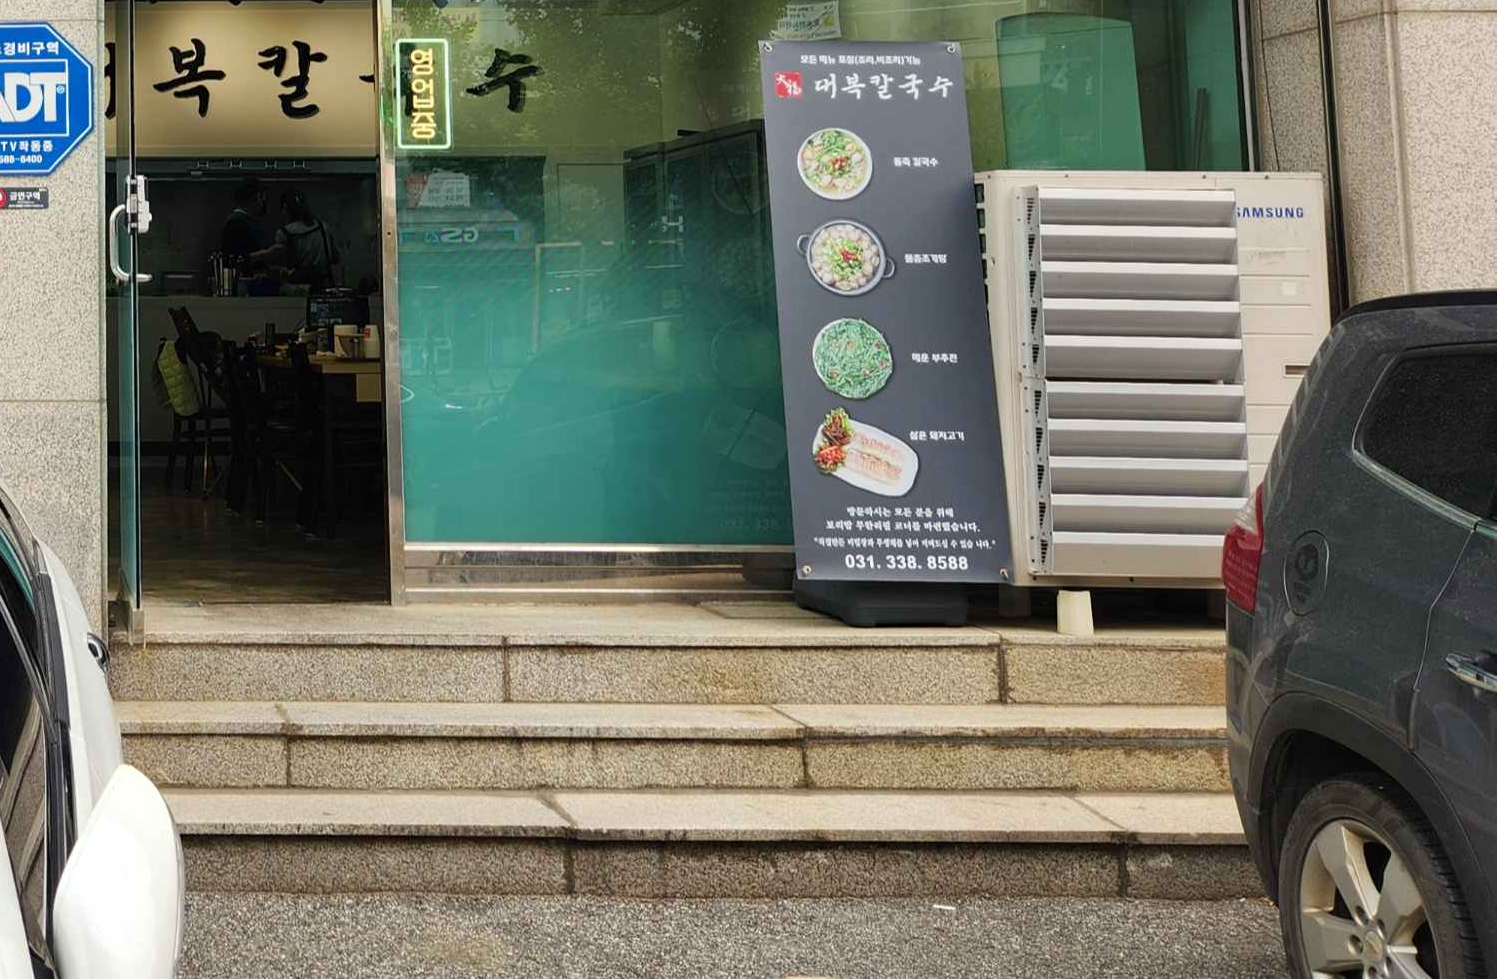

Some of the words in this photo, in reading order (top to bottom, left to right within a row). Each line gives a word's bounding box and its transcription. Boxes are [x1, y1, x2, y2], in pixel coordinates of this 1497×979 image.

[800, 54, 817, 65] 모든
[819, 54, 836, 65] 메뉴
[813, 72, 954, 100] 대복칼국수
[410, 47, 438, 140] 영업중
[912, 156, 939, 167] 칼국수
[9, 191, 42, 201] 금연구역
[929, 430, 964, 442] 돼지고기
[846, 506, 892, 517] 방문하시는
[894, 507, 912, 517] 모든
[936, 507, 954, 518] 위해
[826, 520, 853, 531] 보리밥
[855, 520, 891, 532] 무한리필
[893, 521, 921, 532] 코너를
[950, 539, 959, 549] 수
[844, 553, 881, 569] 031.
[886, 554, 922, 570] 338.
[927, 555, 969, 571] 8588
